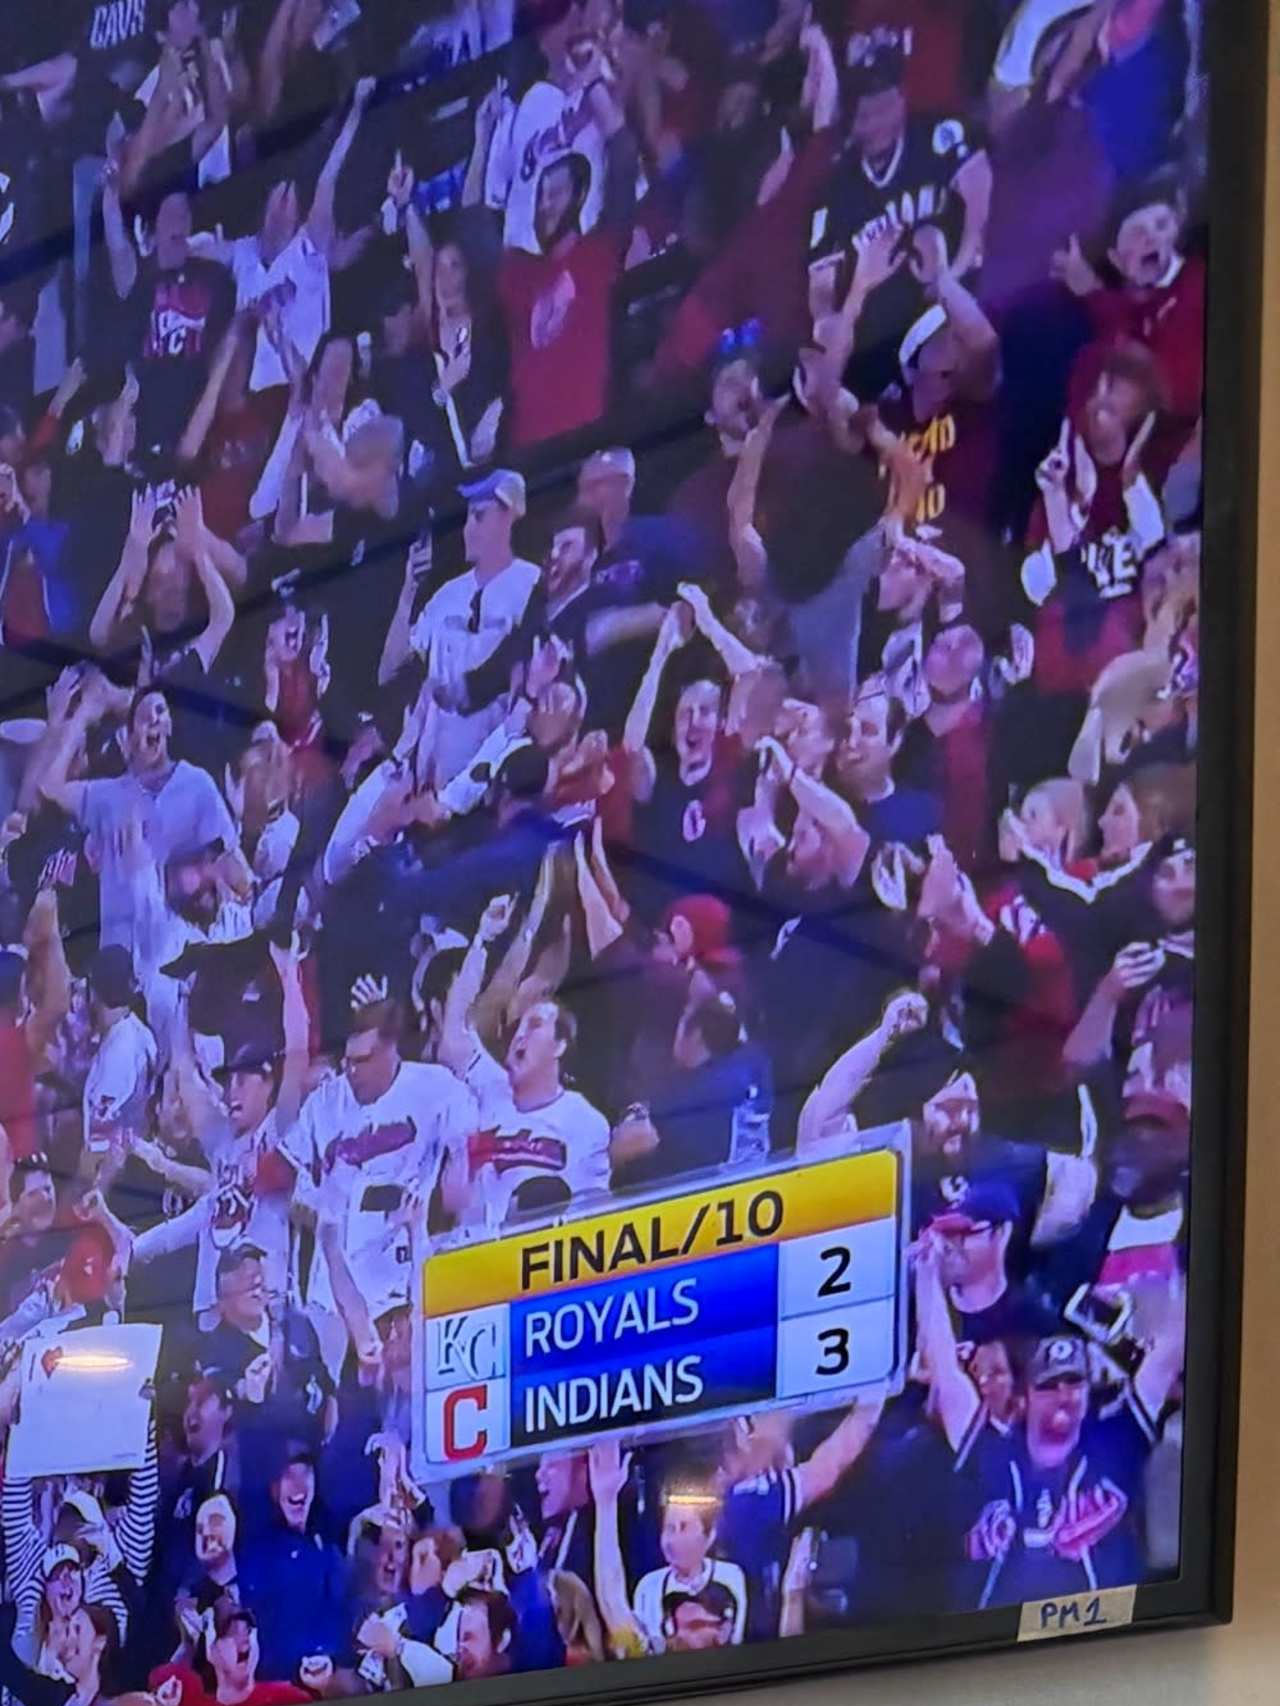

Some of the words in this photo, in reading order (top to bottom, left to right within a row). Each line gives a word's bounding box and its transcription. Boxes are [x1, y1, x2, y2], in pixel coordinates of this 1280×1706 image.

[520, 1190, 784, 1291] FINAL/10
[526, 1279, 699, 1357] ROYALS
[817, 1246, 851, 1297] 2
[444, 1384, 487, 1462] C
[526, 1355, 703, 1433] INDIANS
[814, 1328, 849, 1376] 3
